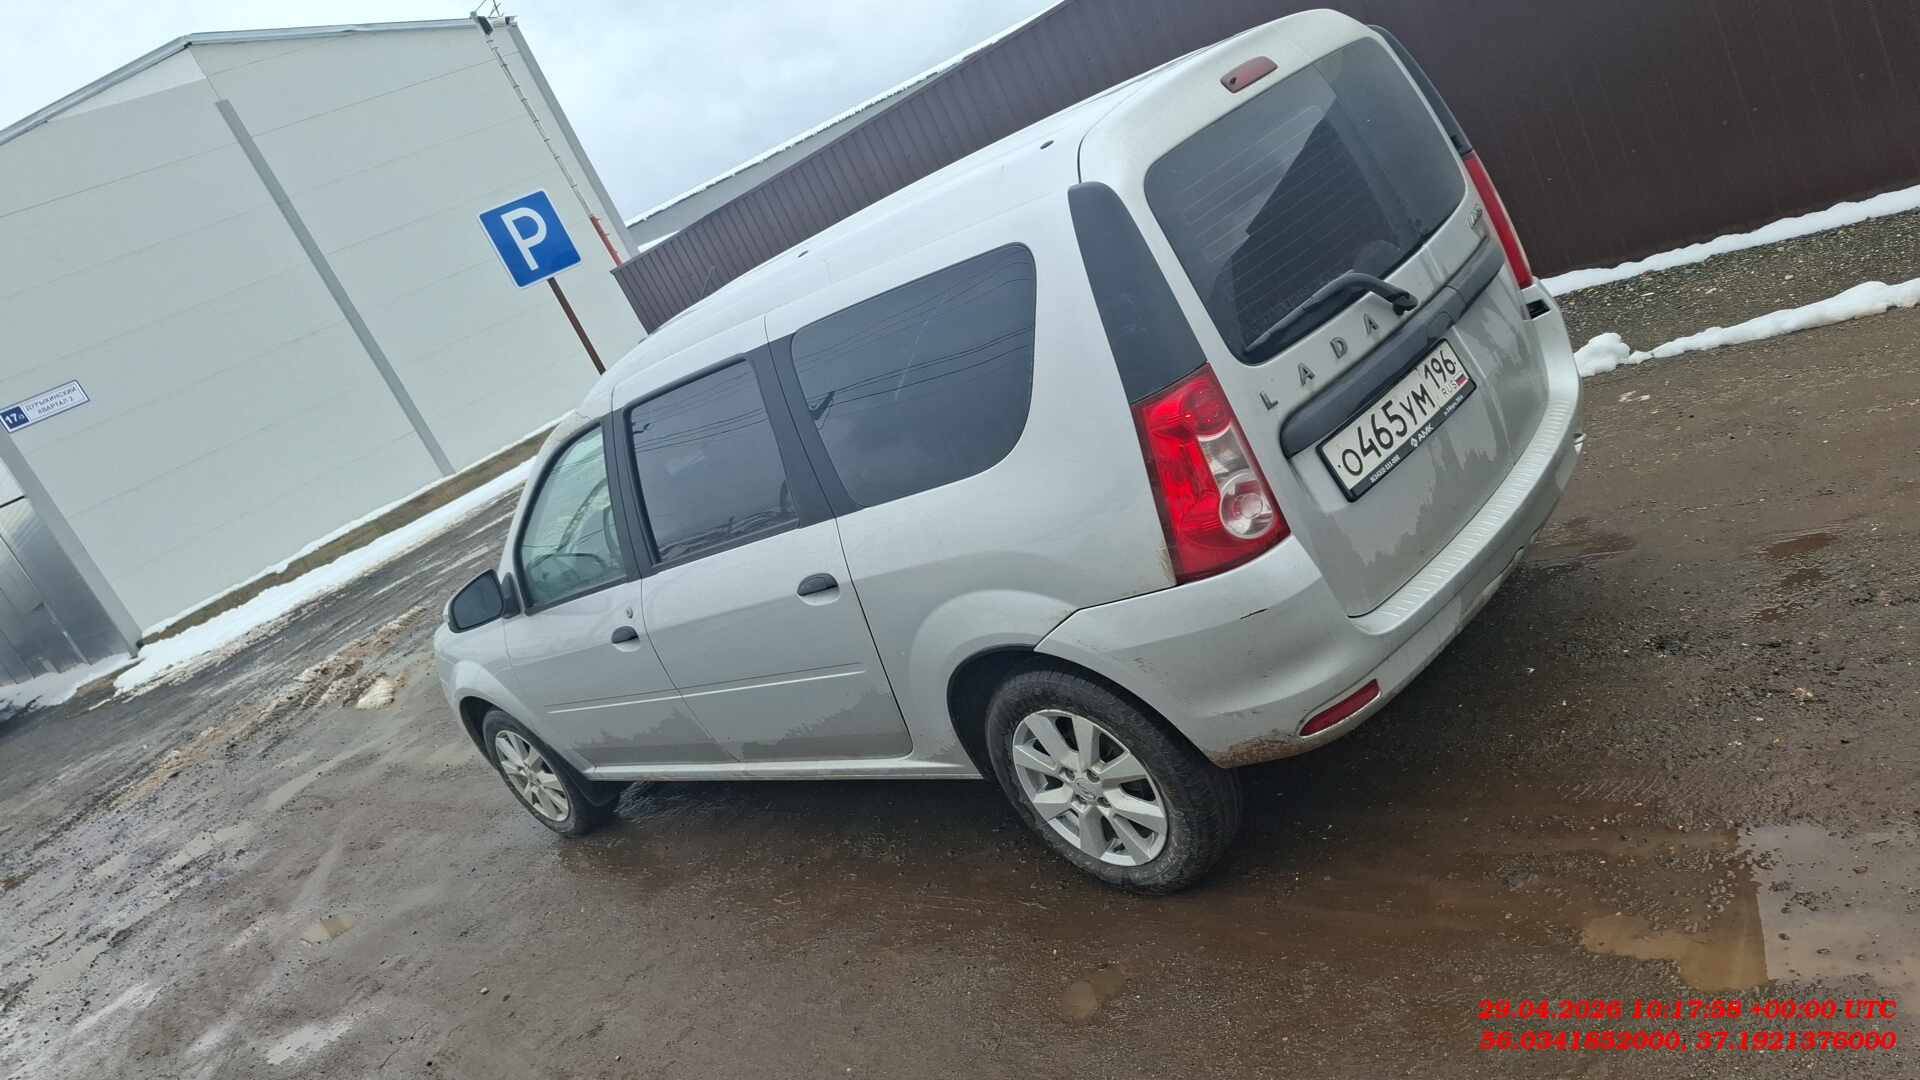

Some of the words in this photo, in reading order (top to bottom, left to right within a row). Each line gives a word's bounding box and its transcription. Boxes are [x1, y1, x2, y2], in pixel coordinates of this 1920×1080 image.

[501, 208, 547, 271] P
[1259, 313, 1379, 410] LADA
[1424, 350, 1456, 389] 196
[1441, 381, 1458, 397] RUS
